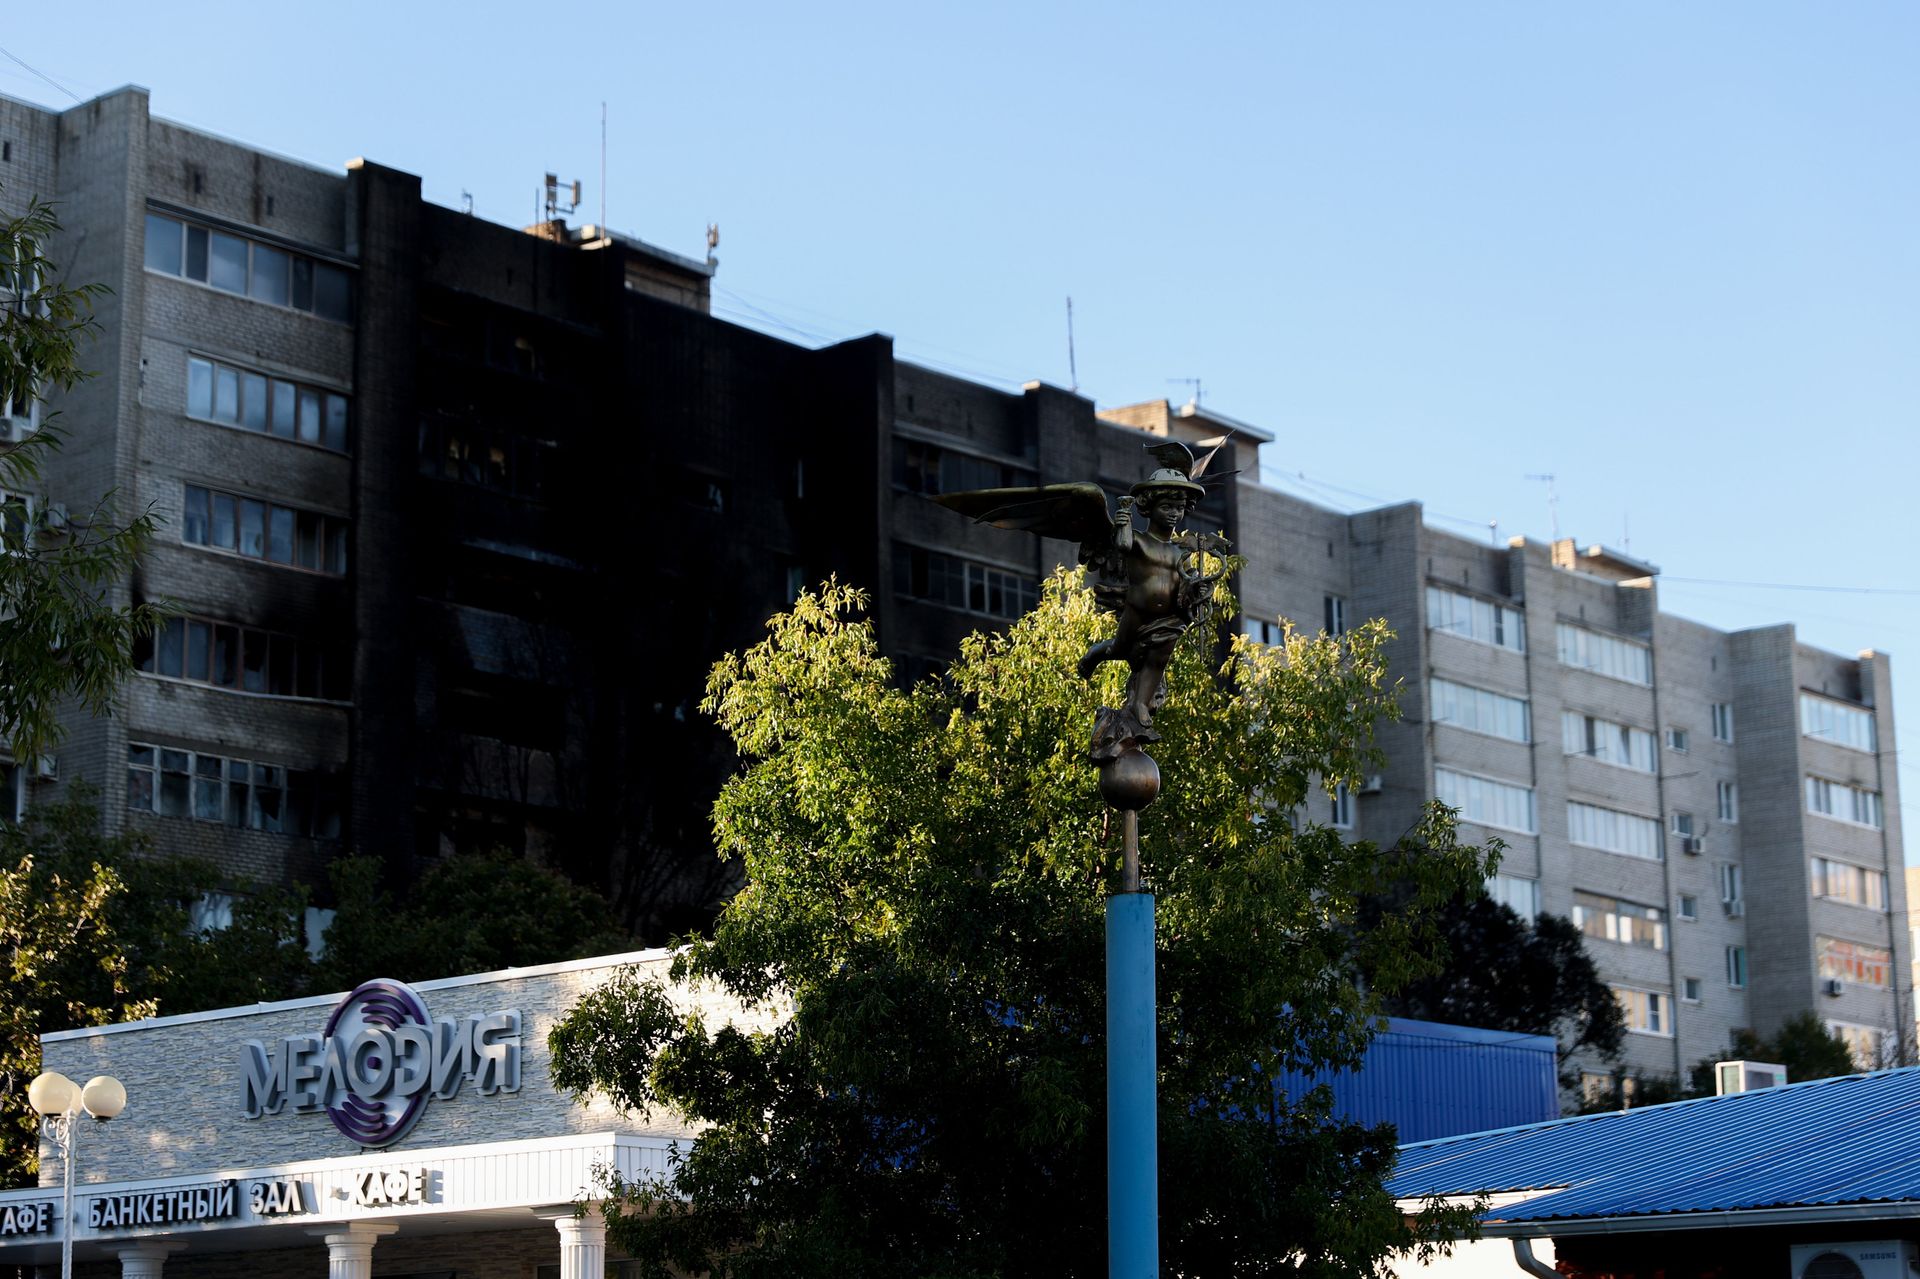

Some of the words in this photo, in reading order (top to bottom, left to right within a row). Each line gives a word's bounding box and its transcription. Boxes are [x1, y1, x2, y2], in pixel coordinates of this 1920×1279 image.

[89, 1179, 235, 1228] БАНКЕТНЫЙ
[250, 1180, 302, 1215] ЗАЛ
[355, 1168, 426, 1206] КАФЕ
[0, 1204, 49, 1235] АФЕ
[1860, 1252, 1897, 1260] SAMSUNG
